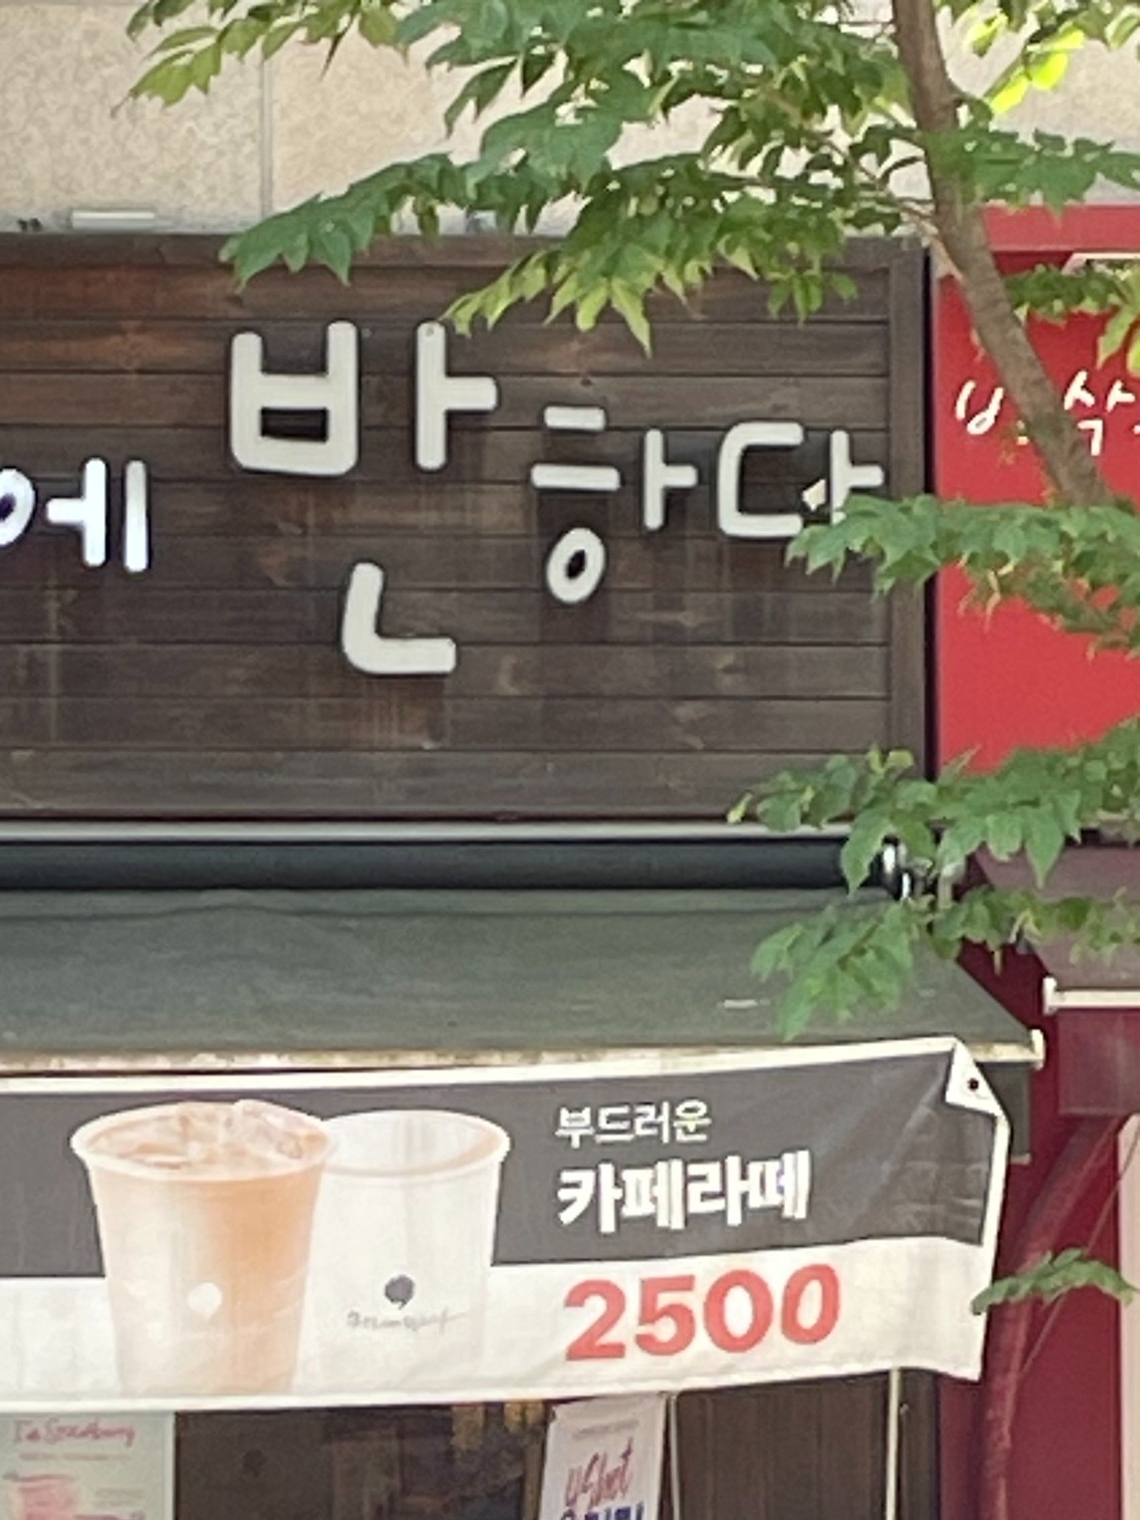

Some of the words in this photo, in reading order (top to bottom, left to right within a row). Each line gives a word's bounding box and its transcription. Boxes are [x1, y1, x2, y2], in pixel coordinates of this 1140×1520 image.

[230, 320, 885, 675] 반하다
[555, 1099, 712, 1149] 부드러운
[557, 1149, 811, 1234] 카페라떼
[563, 1263, 841, 1362] 2500
